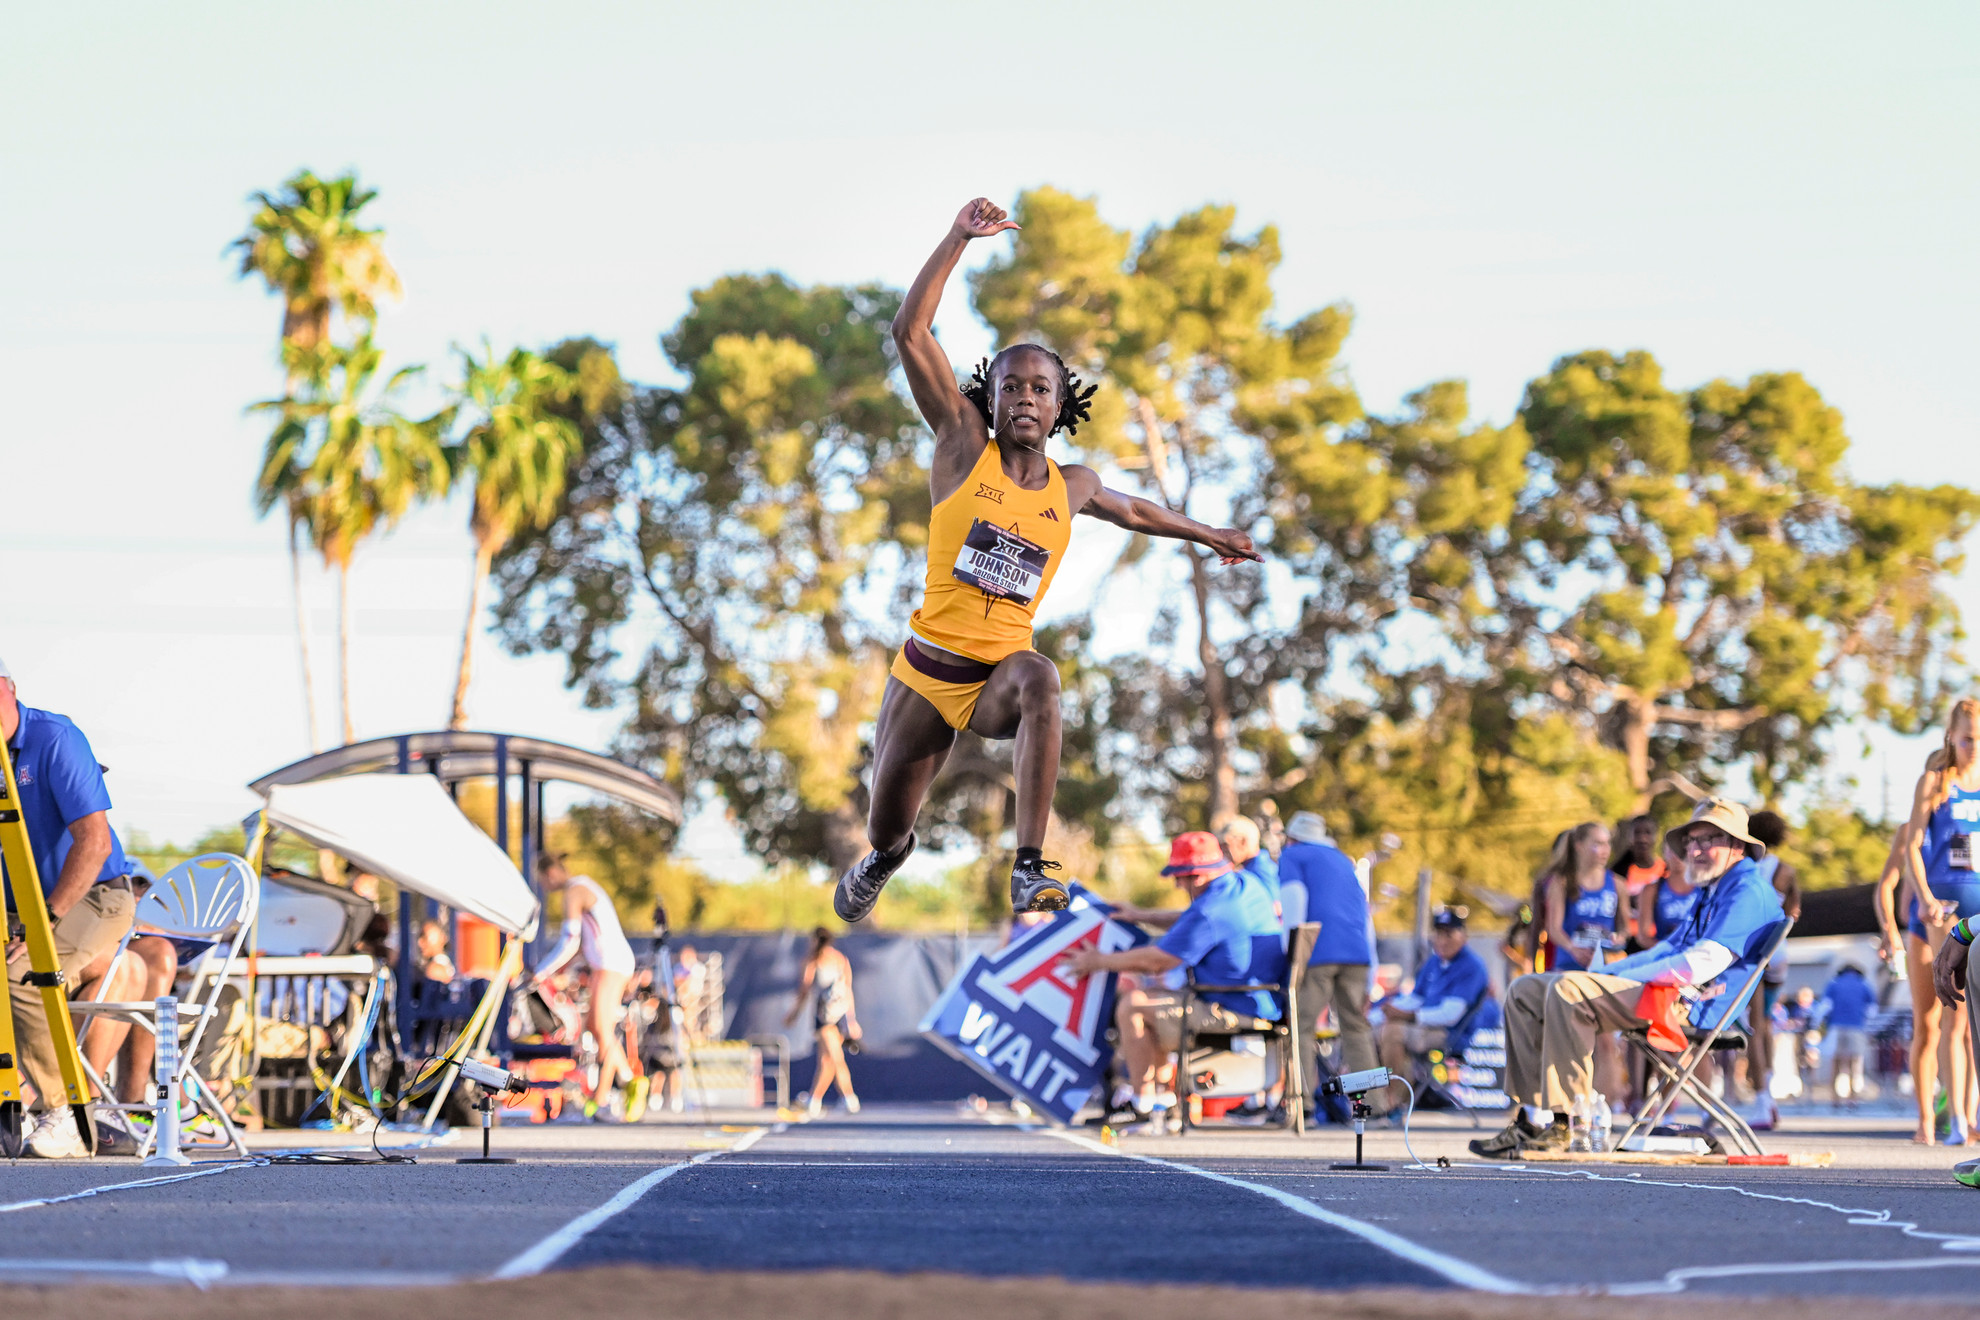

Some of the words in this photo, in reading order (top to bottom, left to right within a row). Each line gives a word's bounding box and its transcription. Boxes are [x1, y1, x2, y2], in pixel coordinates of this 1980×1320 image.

[969, 551, 1030, 587] JOHNSON
[972, 567, 1000, 584] ARIZONA
[1000, 579, 1018, 592] STATE
[975, 895, 1136, 1068] A
[959, 1001, 1080, 1103] WAIT
